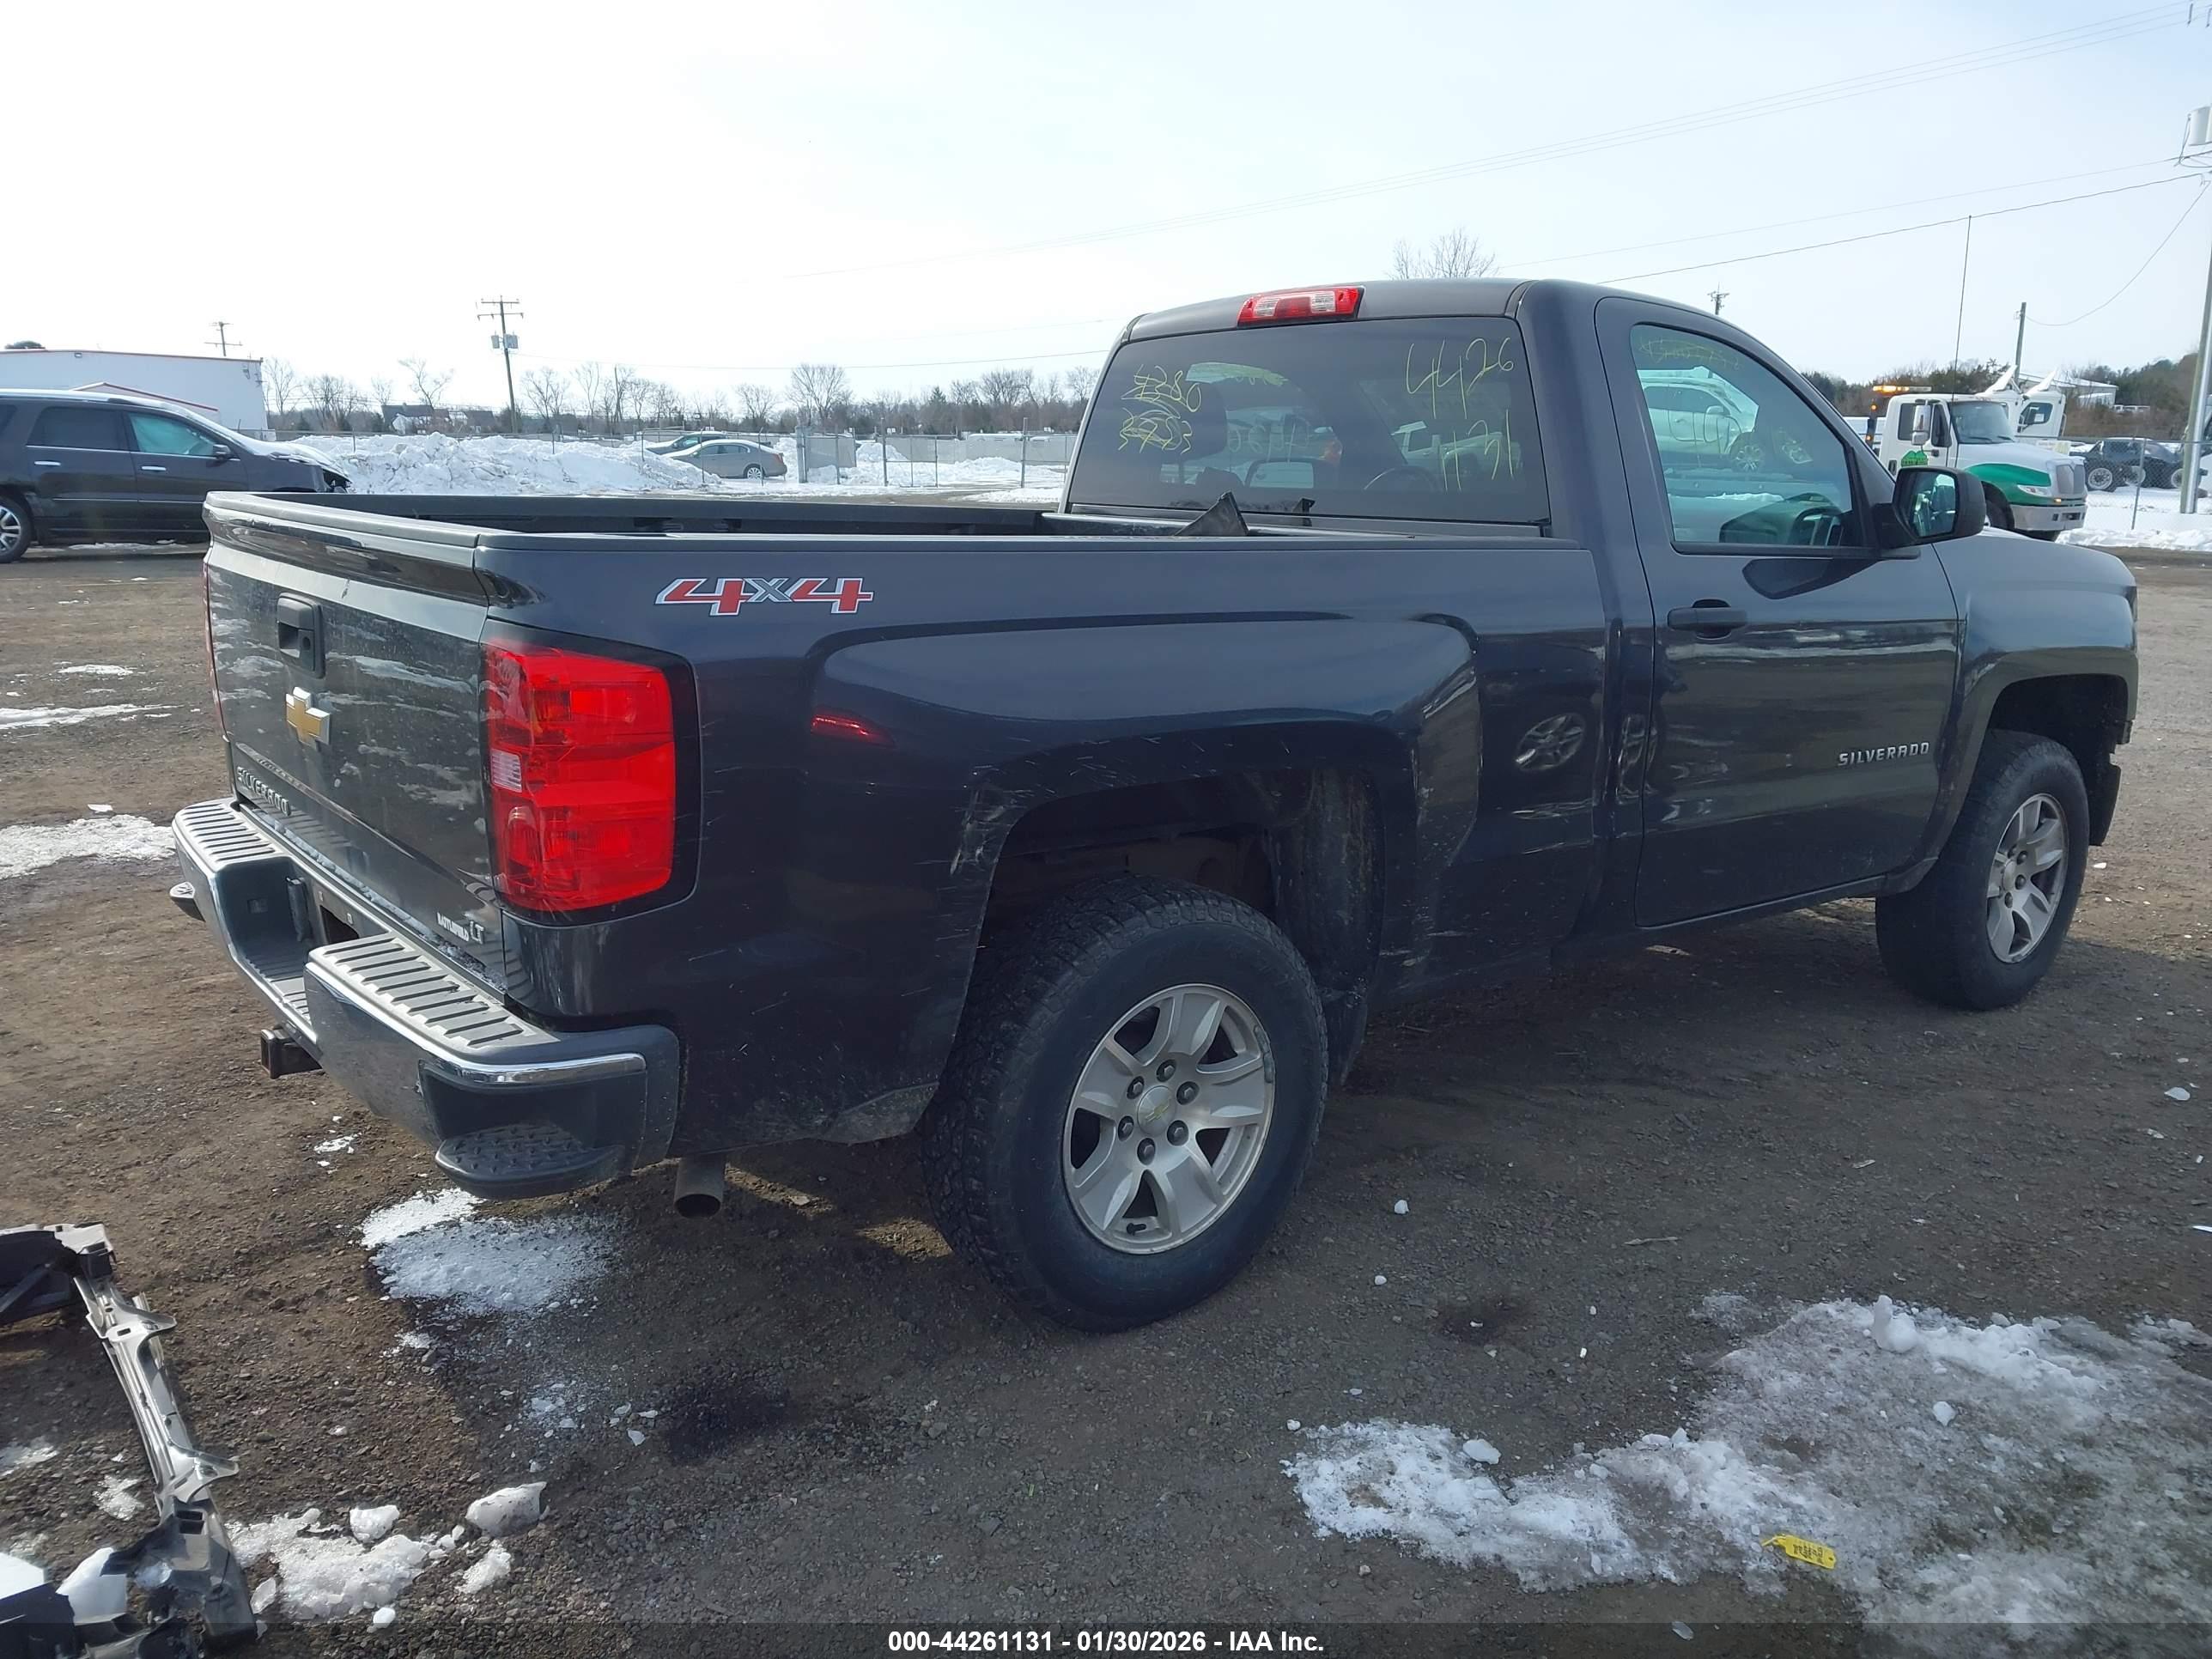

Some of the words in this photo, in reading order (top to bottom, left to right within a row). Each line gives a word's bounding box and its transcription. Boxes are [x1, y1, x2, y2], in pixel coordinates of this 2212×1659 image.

[1407, 337, 1514, 419] 4426
[1838, 742, 1929, 766] SILVERADO
[237, 766, 289, 817] SILVERADO
[470, 920, 485, 945] LT
